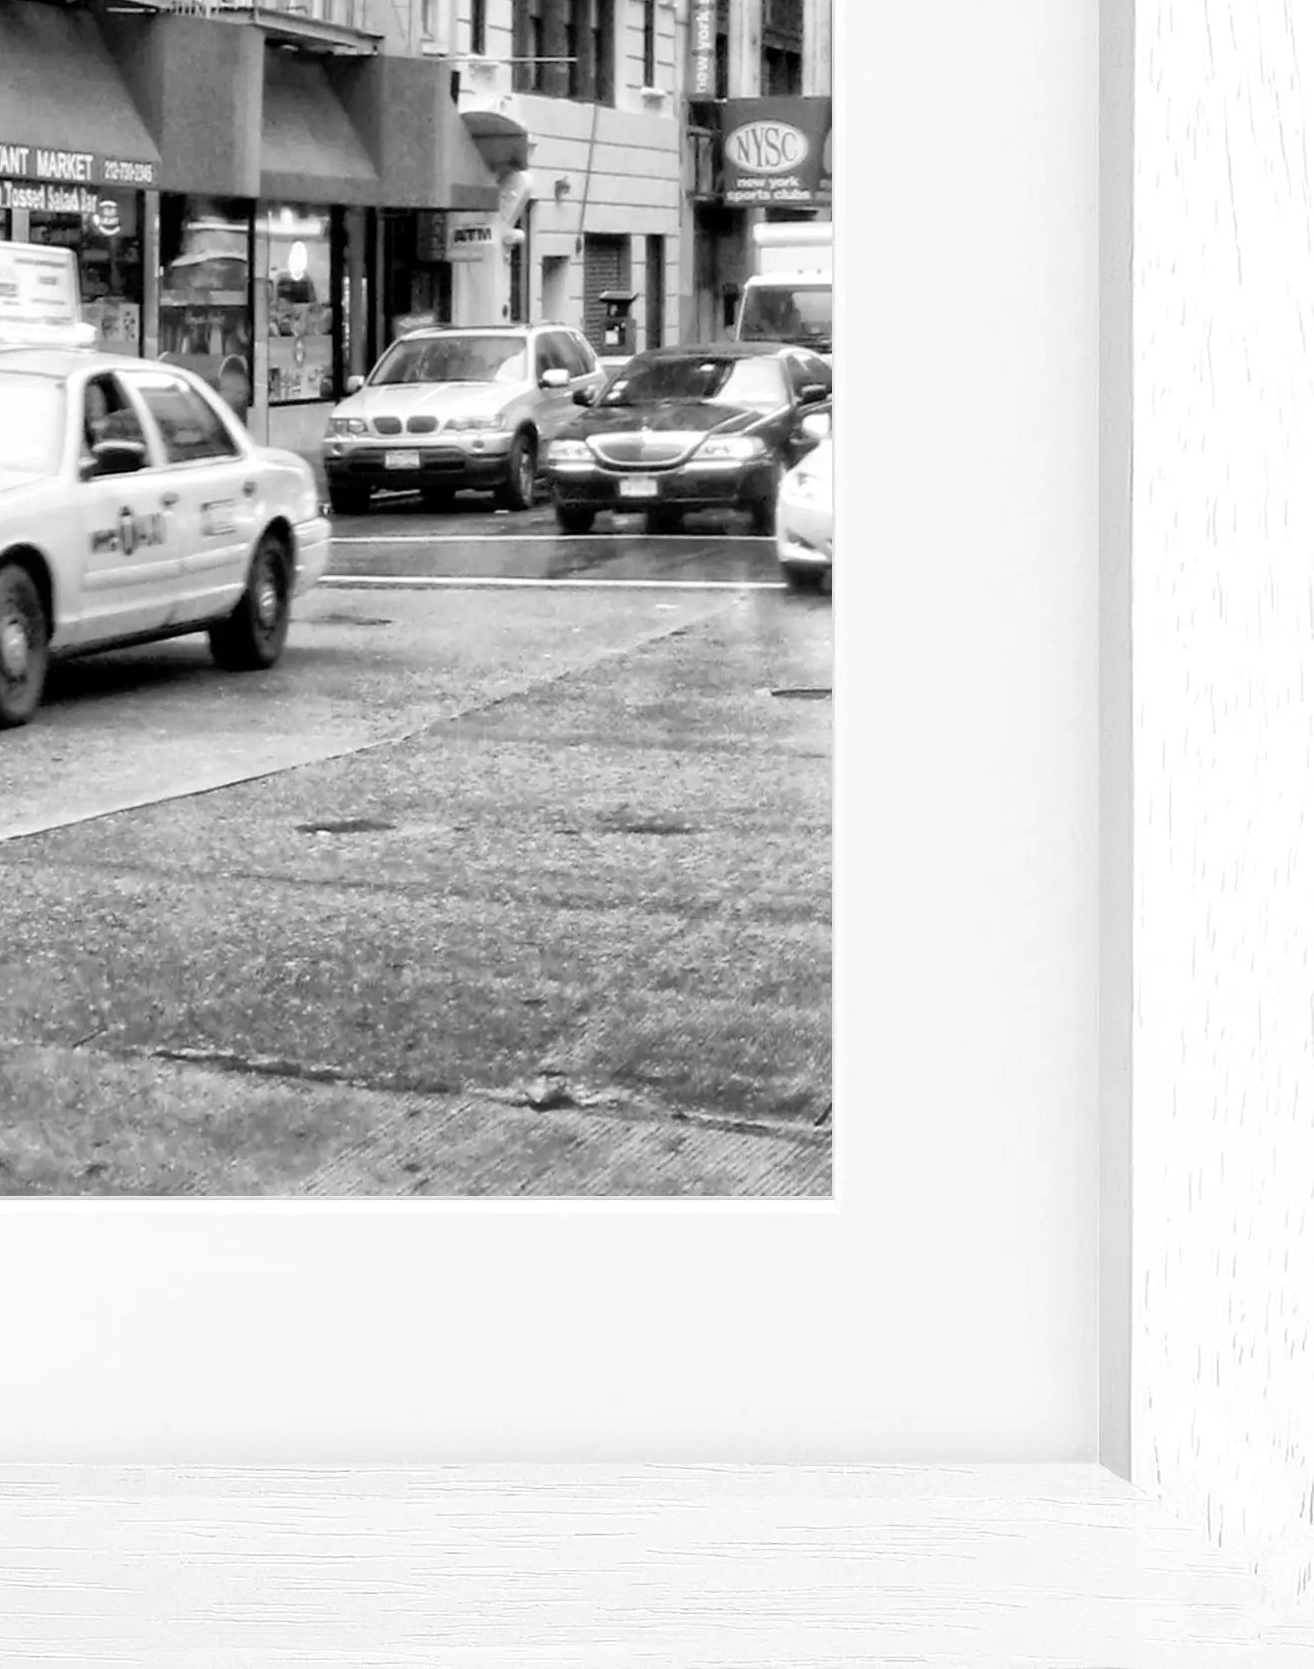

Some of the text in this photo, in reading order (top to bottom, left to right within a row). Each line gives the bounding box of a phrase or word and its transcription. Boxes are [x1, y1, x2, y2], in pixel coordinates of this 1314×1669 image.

[696, 9, 712, 53] york
[695, 56, 710, 94] new
[735, 126, 798, 168] NYSC
[37, 148, 94, 181] MARKET
[727, 190, 771, 202] sports
[773, 189, 810, 200] clubs
[736, 176, 799, 190] new york
[454, 227, 492, 242] ATM
